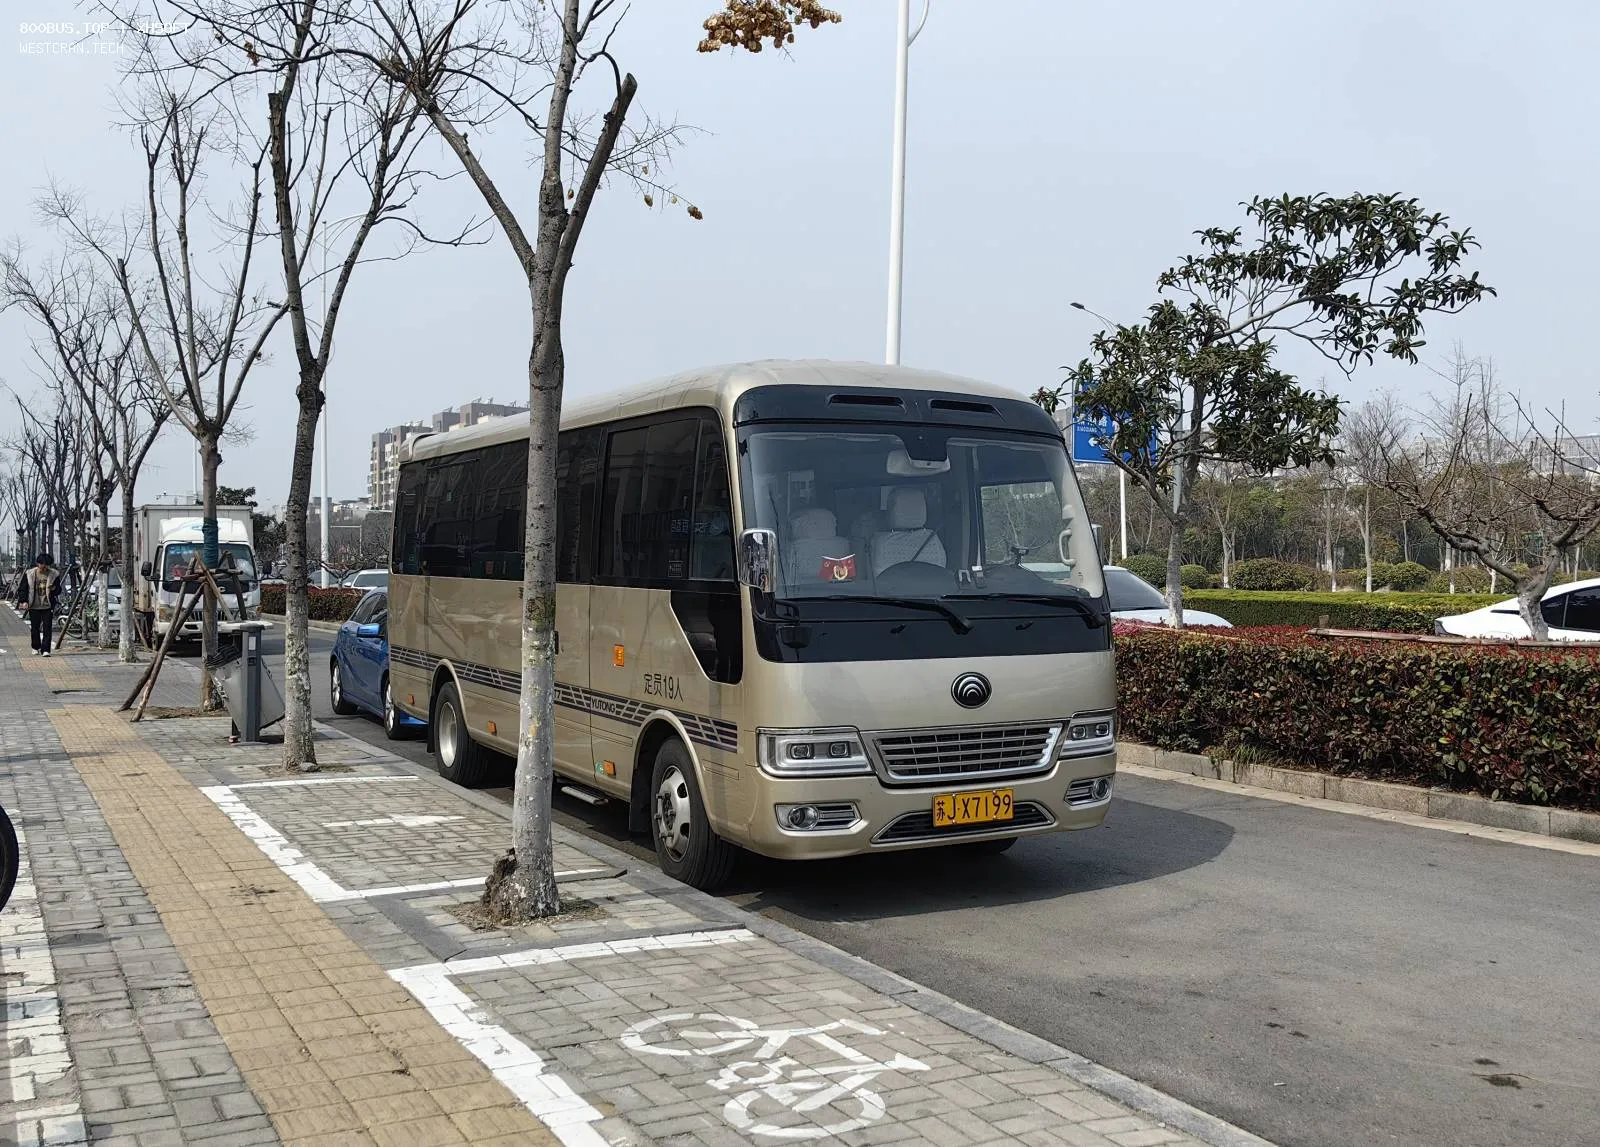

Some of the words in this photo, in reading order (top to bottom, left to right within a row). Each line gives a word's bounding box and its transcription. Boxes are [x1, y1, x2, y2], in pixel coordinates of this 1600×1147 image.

[643, 673, 684, 702] 定员19人
[591, 698, 616, 713] YUTONG
